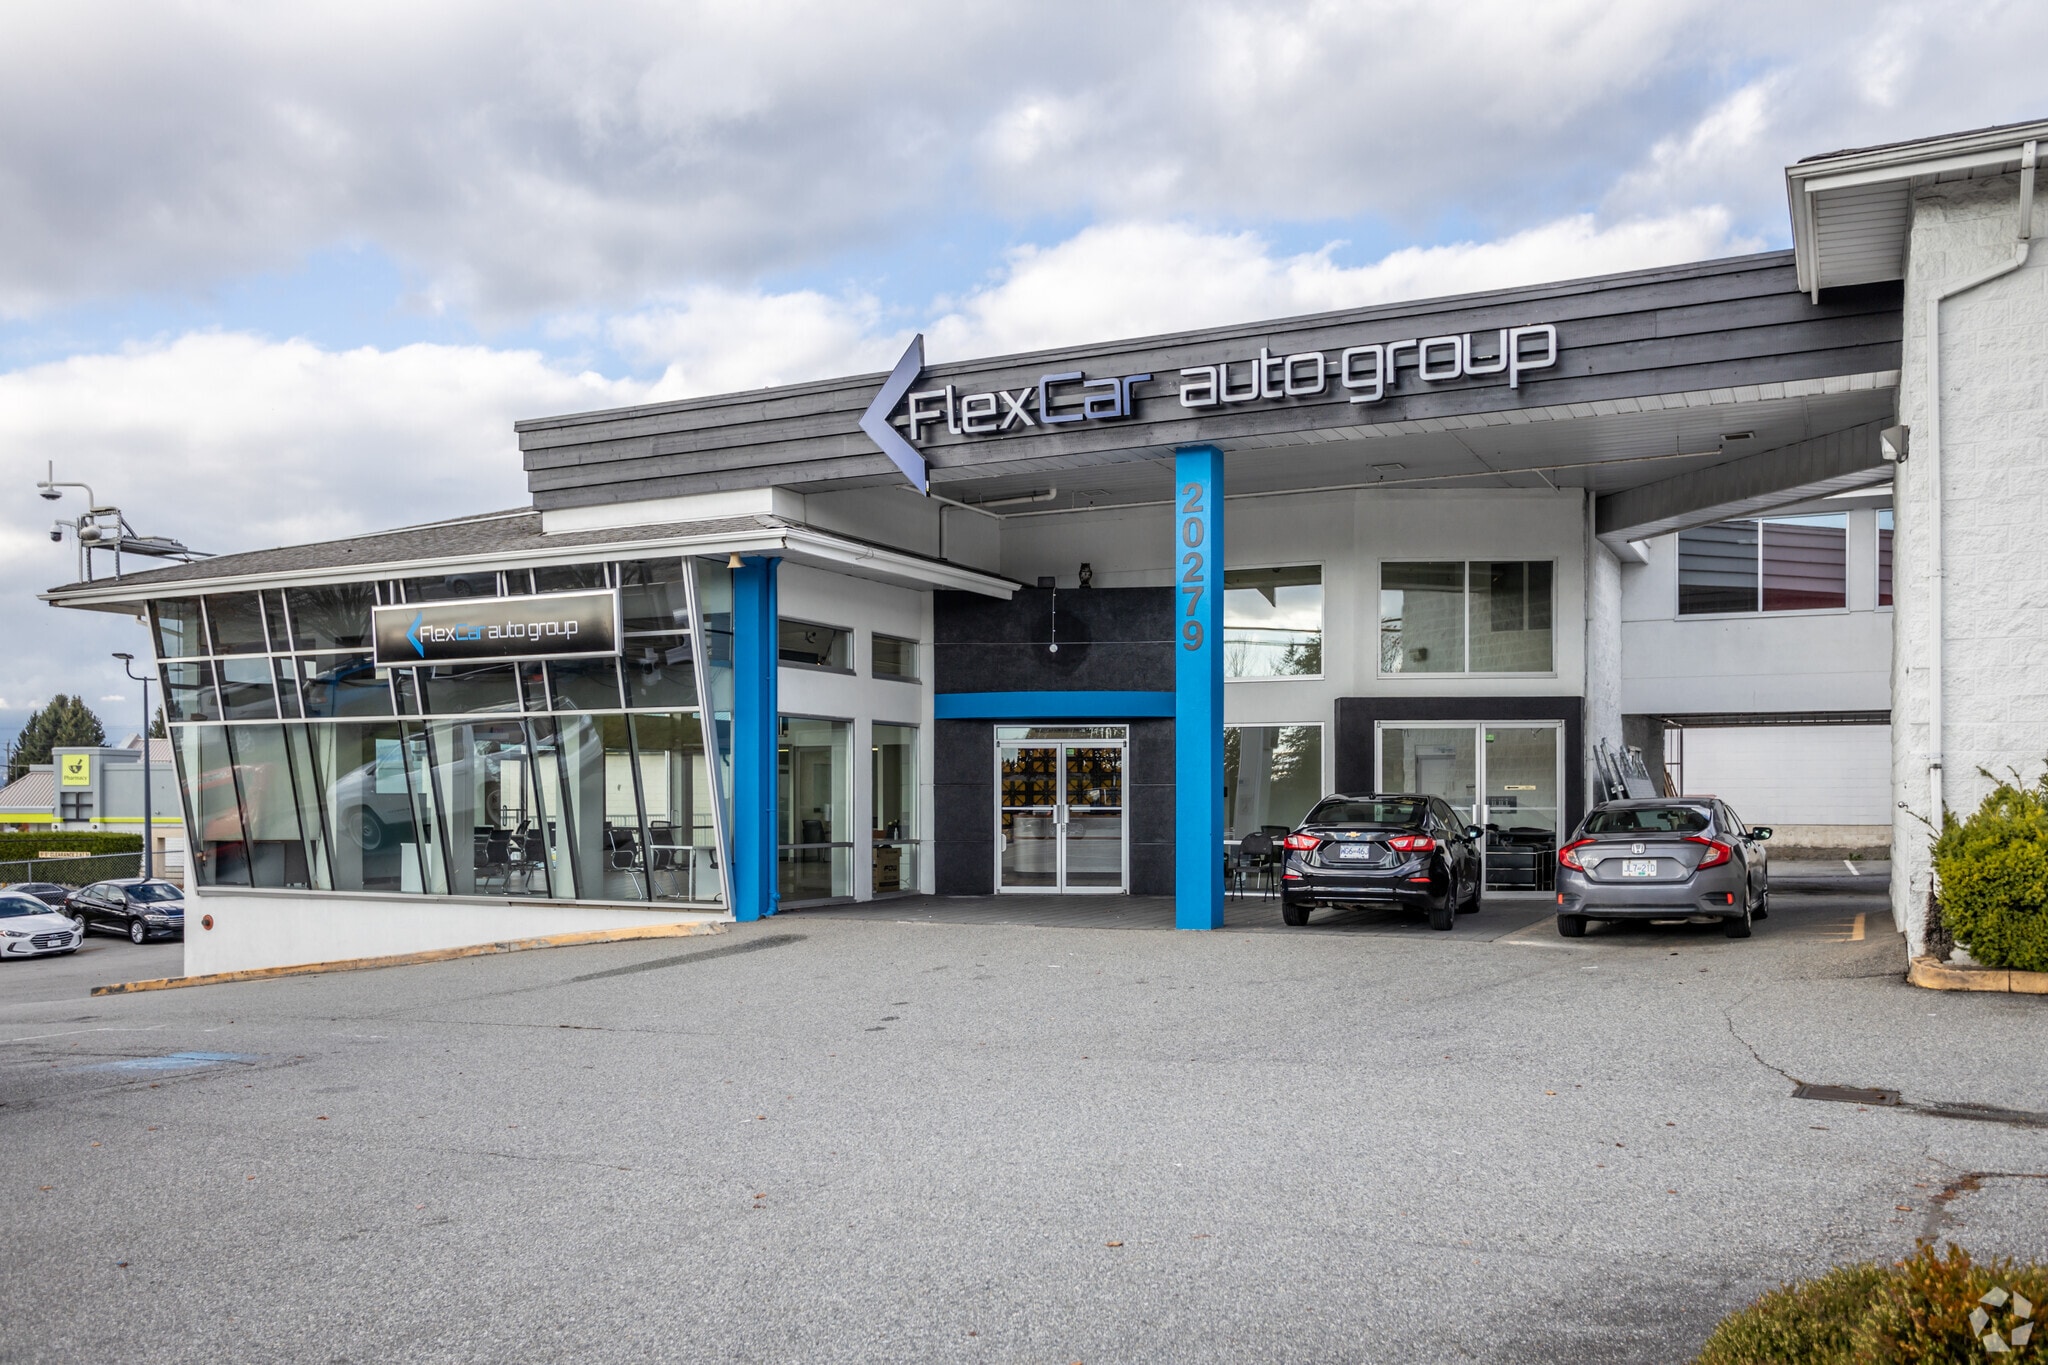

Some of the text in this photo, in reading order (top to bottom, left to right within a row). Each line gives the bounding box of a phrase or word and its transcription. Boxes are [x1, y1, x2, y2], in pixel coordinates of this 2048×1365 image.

[909, 324, 1557, 440] FlexCar auto group
[1182, 482, 1205, 651] 20279
[419, 620, 578, 643] FlexCar auto group
